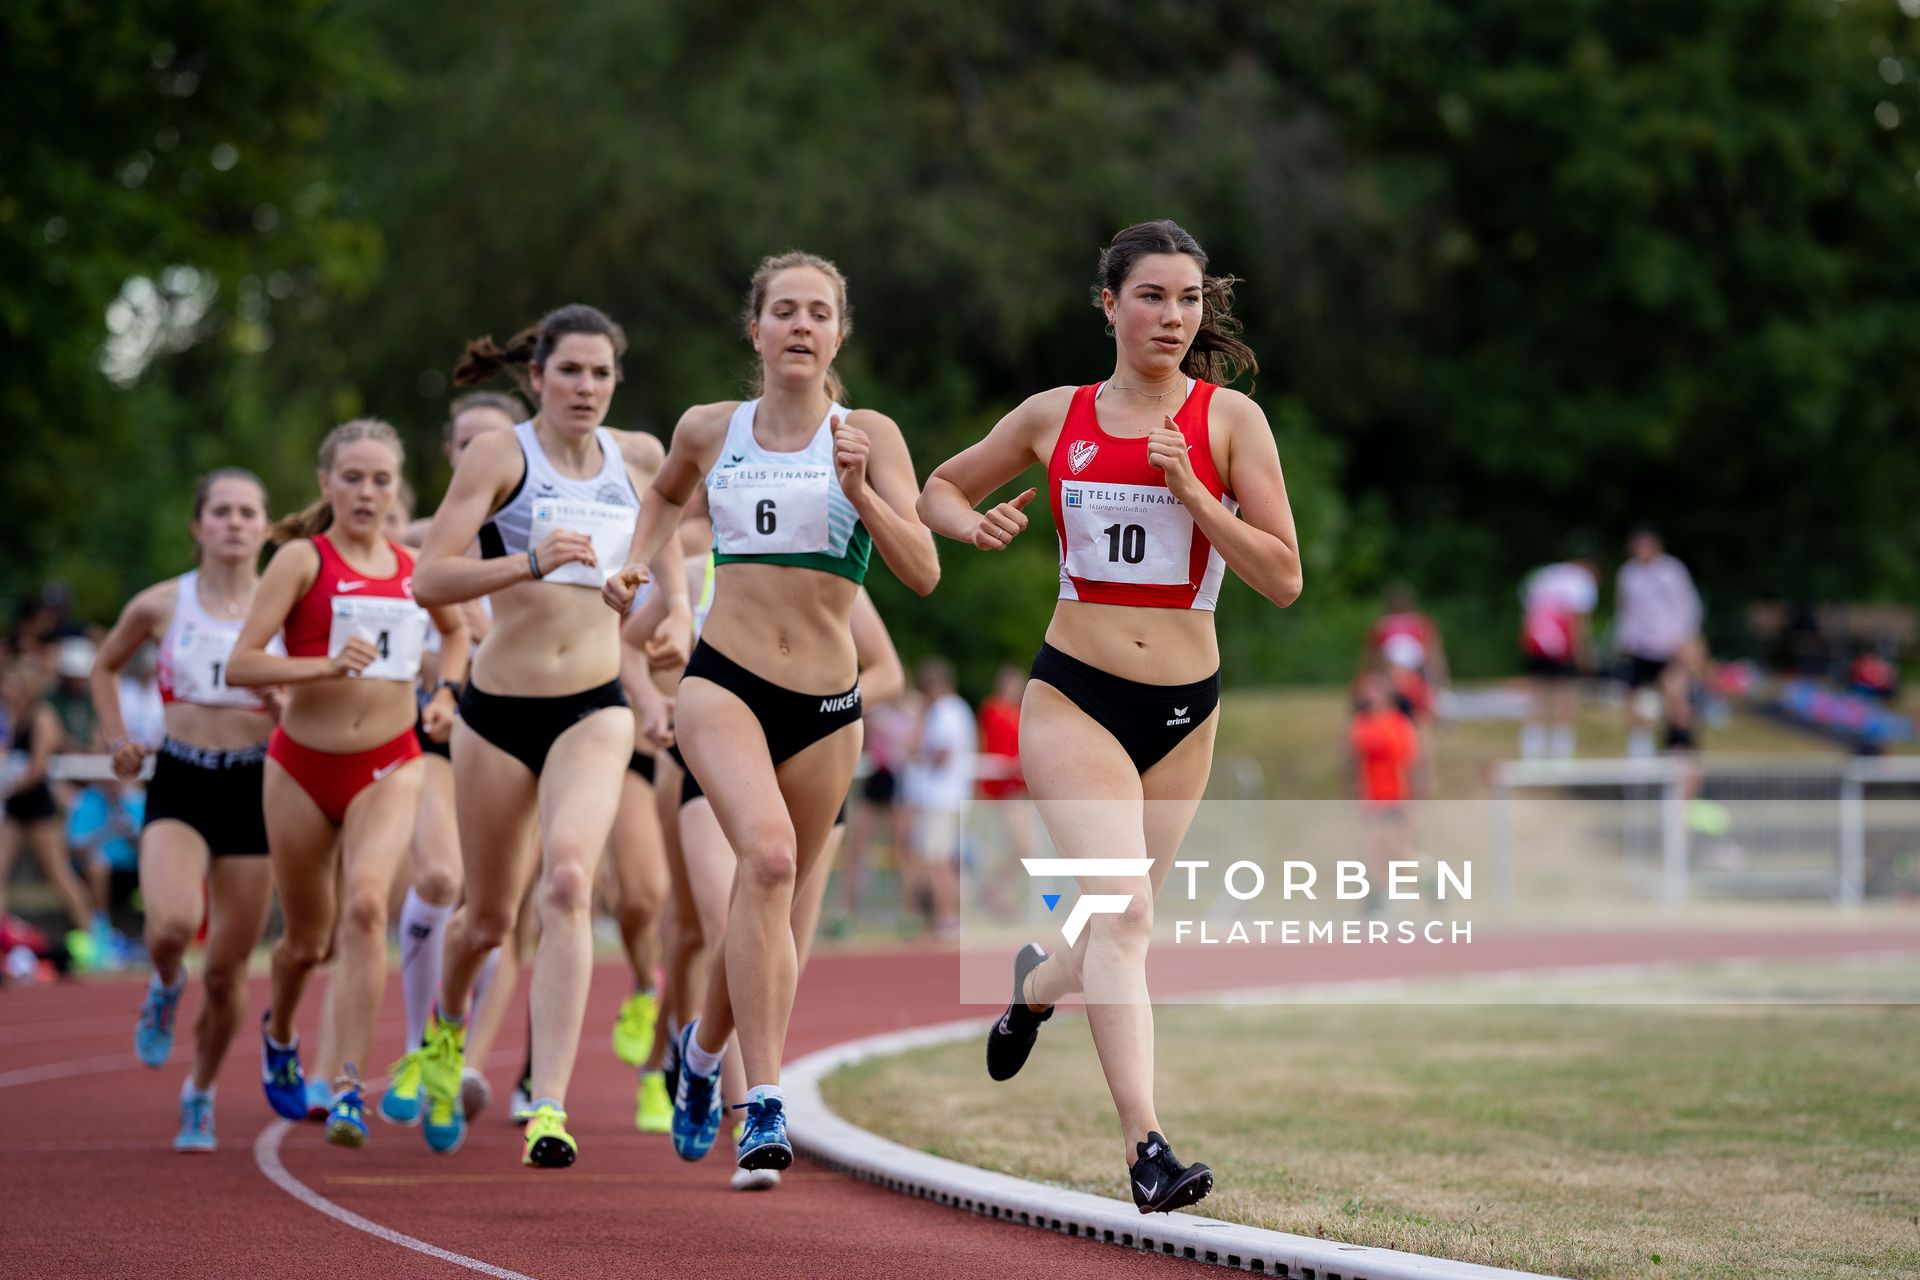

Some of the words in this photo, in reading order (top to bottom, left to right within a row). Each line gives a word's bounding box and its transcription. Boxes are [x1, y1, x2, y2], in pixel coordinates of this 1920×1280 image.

[1088, 490, 1126, 502] TELIS
[756, 499, 777, 536] 6
[1088, 503, 1148, 513] Aktiengesellschaft
[1103, 523, 1146, 564] 10
[376, 631, 389, 659] 4
[819, 692, 855, 713] NIKE
[1166, 717, 1191, 726] erima
